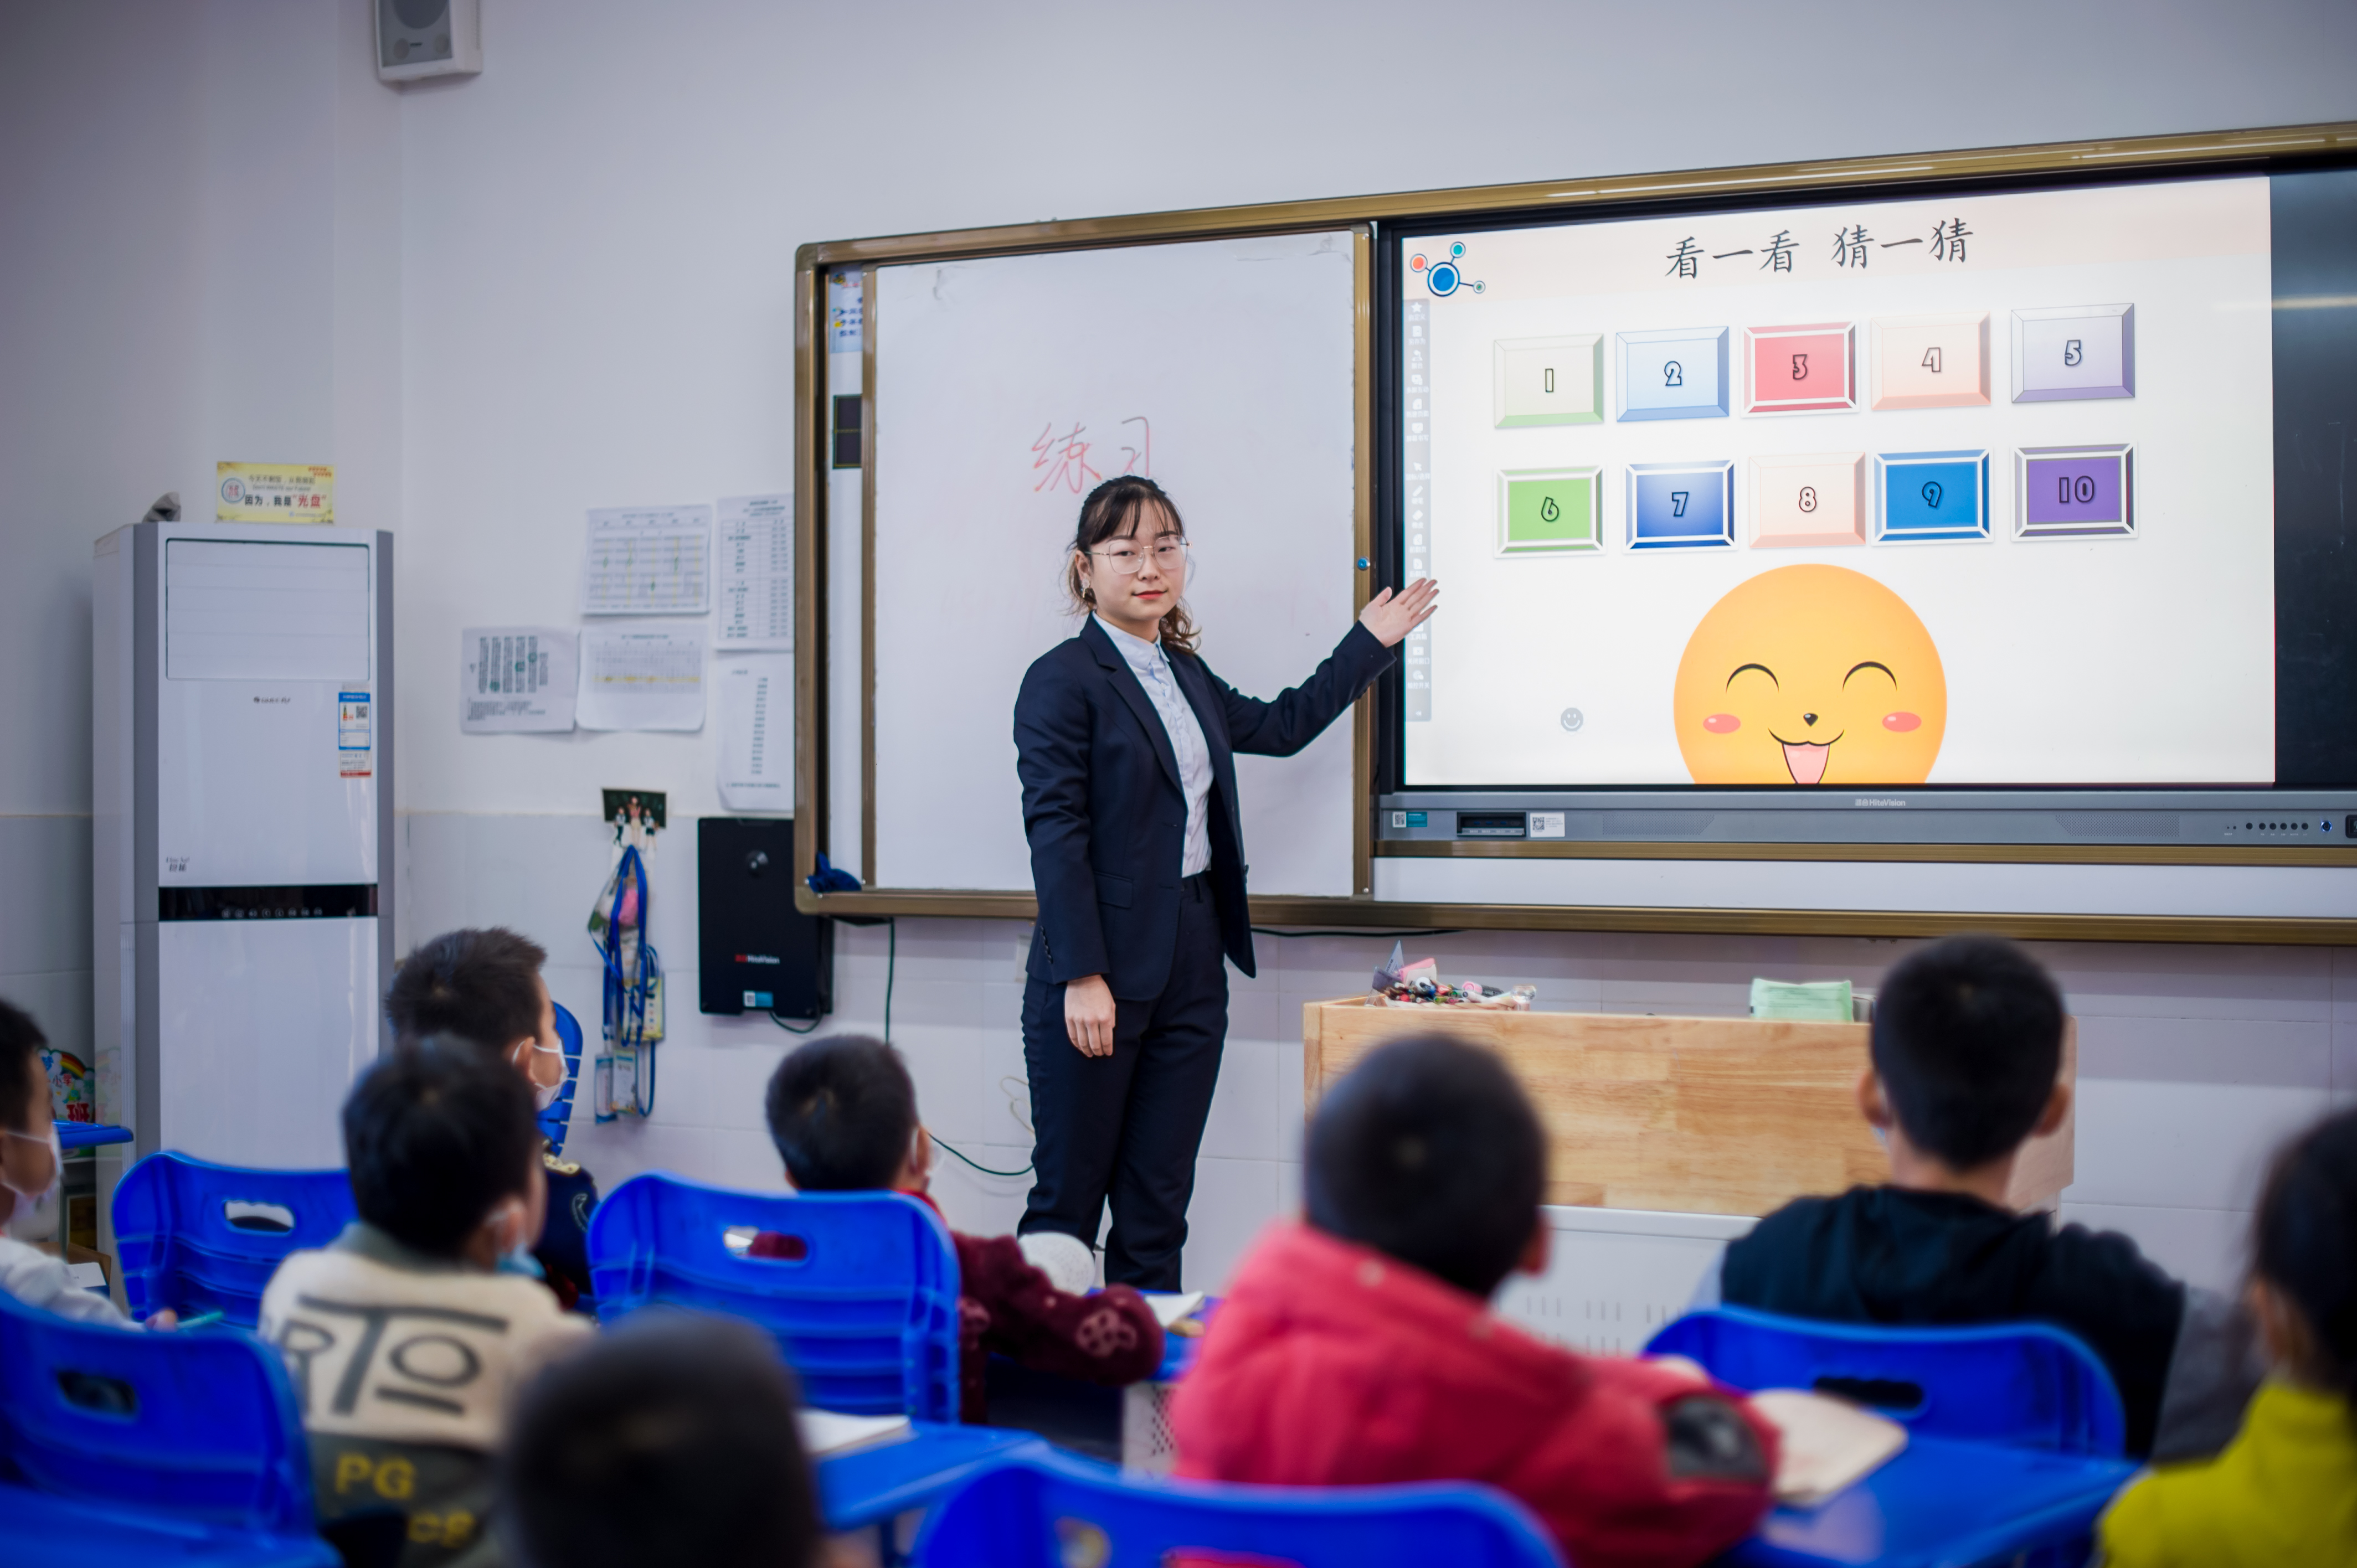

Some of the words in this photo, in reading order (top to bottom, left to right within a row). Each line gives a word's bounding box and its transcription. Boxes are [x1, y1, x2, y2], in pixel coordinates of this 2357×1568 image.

[1665, 229, 1800, 279] 看一看
[1831, 217, 1974, 269] 猜一猜
[1792, 353, 1808, 380] 3
[1921, 347, 1942, 373] 4
[2063, 339, 2082, 367] 5
[1544, 368, 1554, 393] 1
[1664, 360, 1682, 386] 2
[1031, 416, 1151, 494] 练习
[1798, 486, 1817, 513] 8
[1921, 481, 1942, 508] 9
[2058, 475, 2095, 503] 10
[1541, 496, 1560, 522] 6
[1671, 491, 1689, 517] 7
[1869, 798, 1906, 807] HiteVision
